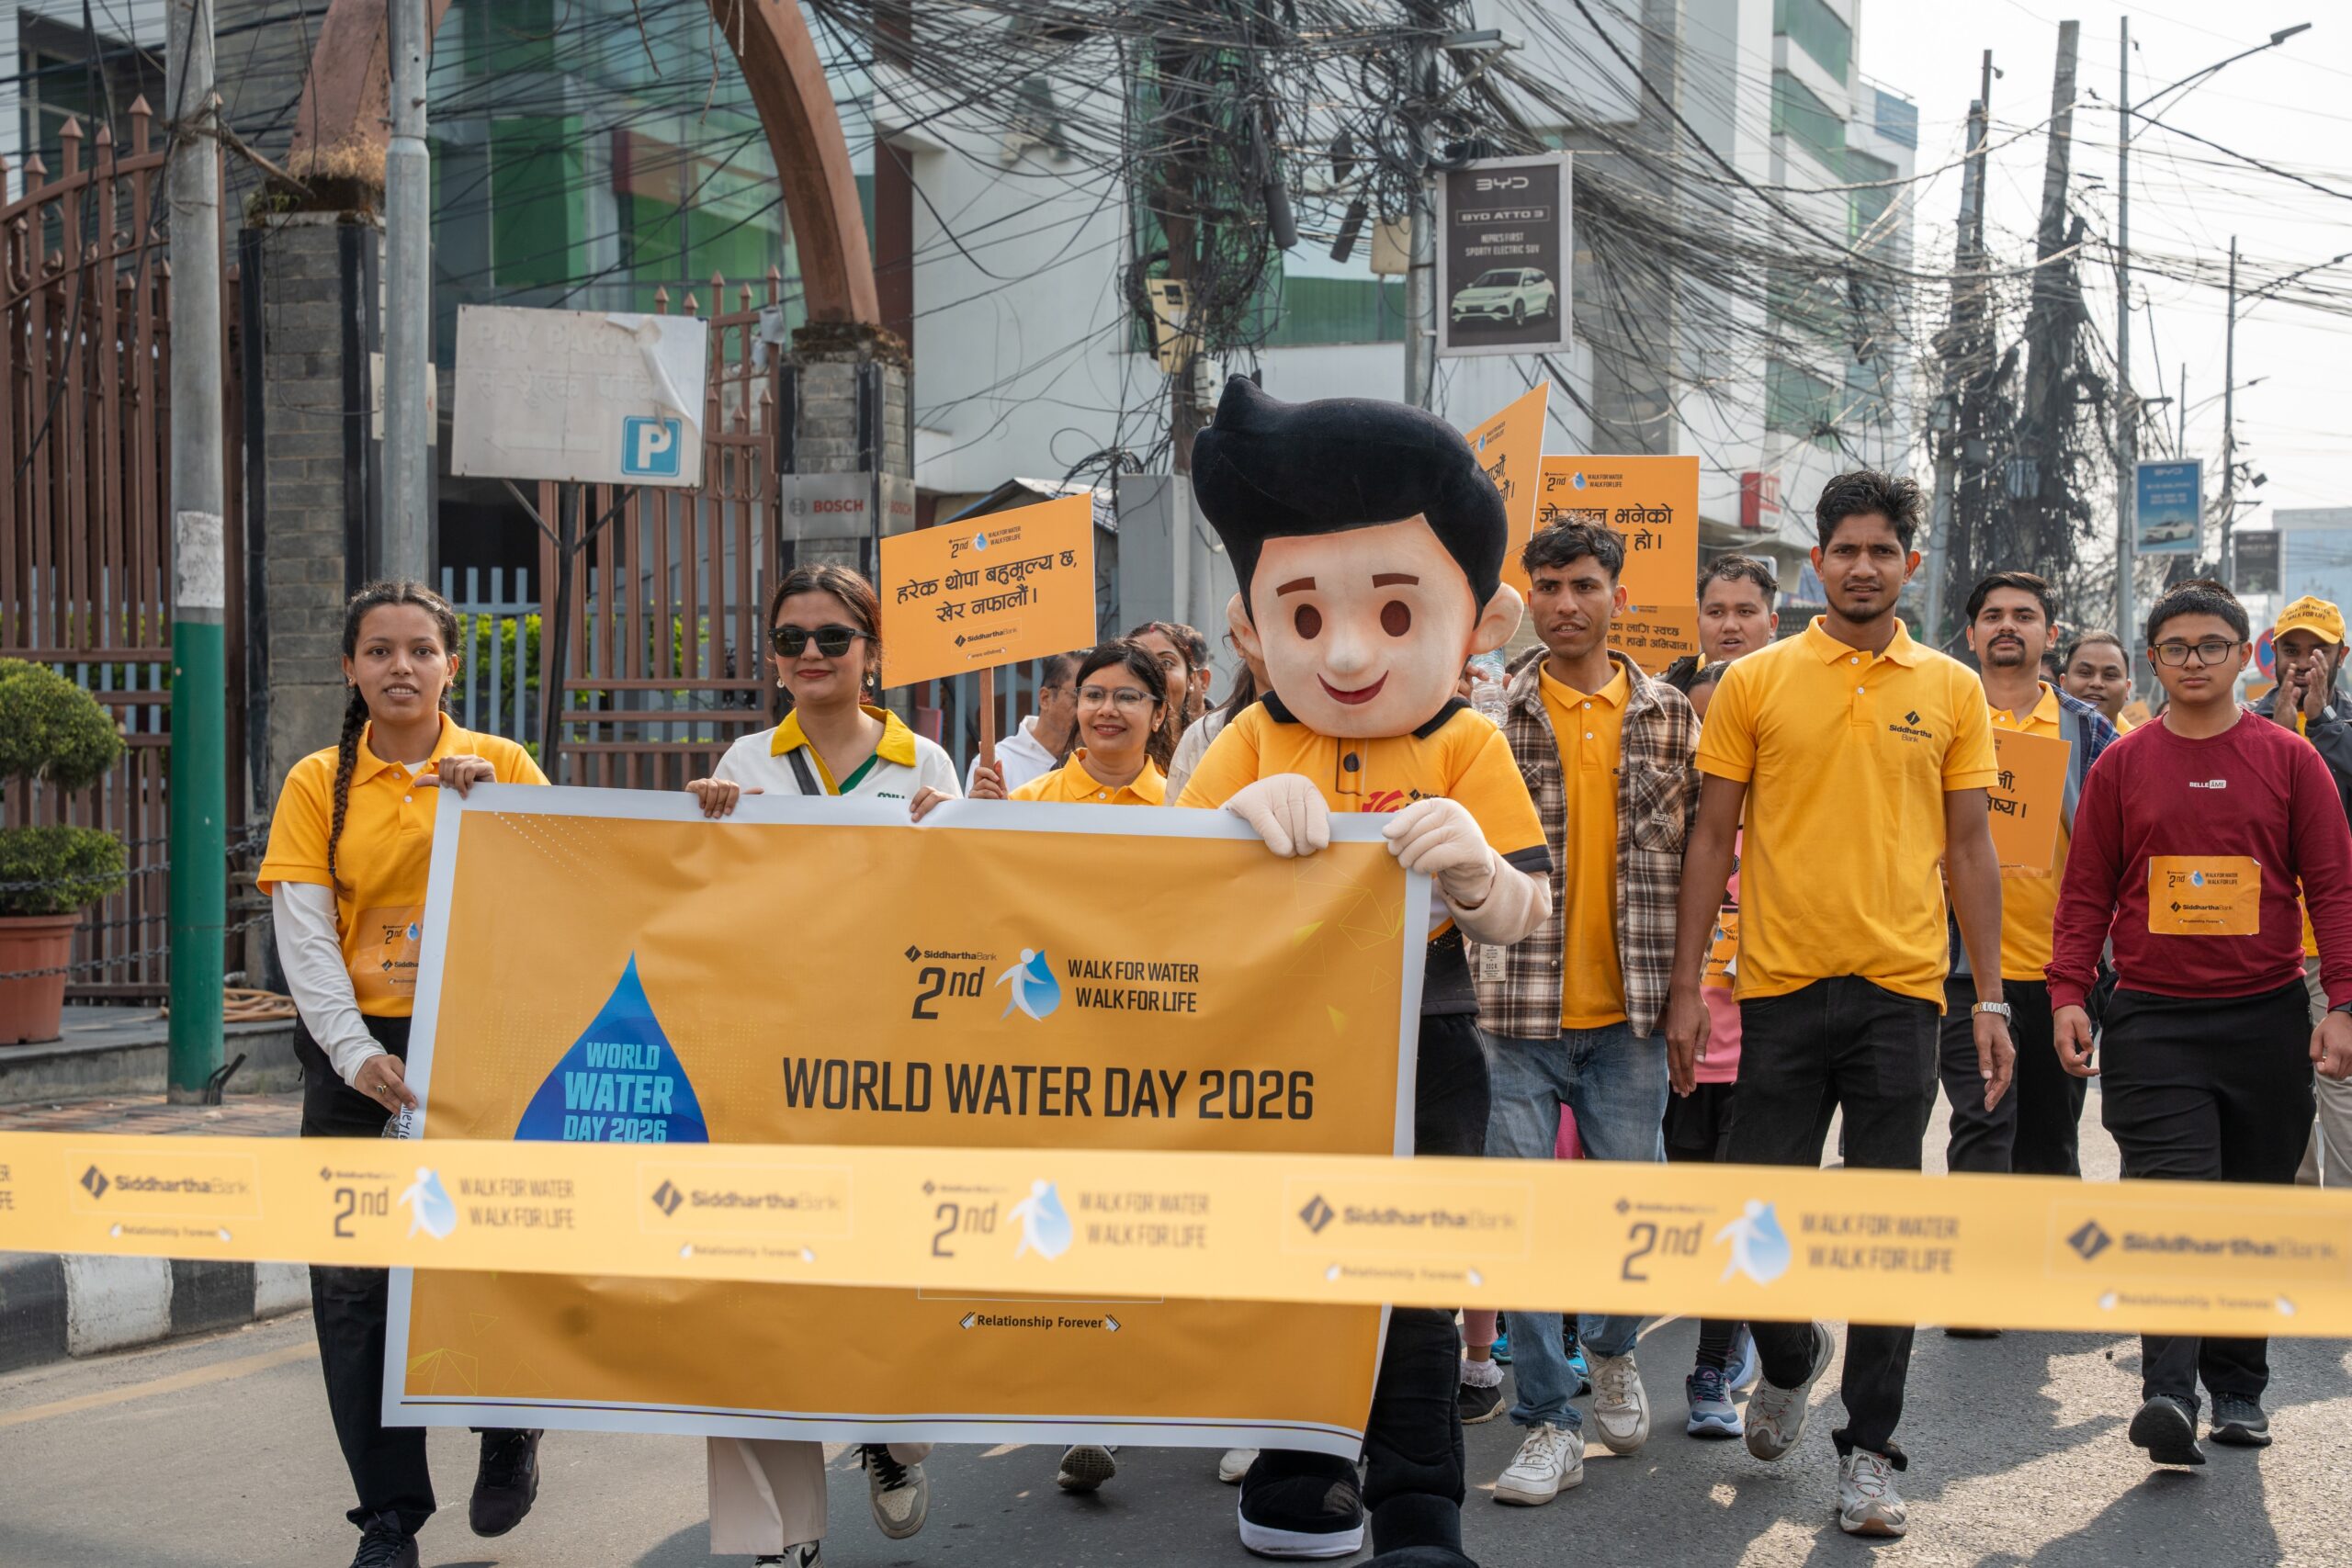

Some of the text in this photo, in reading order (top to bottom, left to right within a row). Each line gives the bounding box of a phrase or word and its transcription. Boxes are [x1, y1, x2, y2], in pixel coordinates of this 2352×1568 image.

[1476, 176, 1529, 191] BYD
[1462, 213, 1490, 221] BYD
[1494, 210, 1531, 220] ATTO
[1493, 245, 1524, 255] ELECTRIC
[638, 423, 672, 468] P
[1547, 478, 1566, 491] 2nd
[813, 500, 864, 513] BOSCH
[1615, 503, 1673, 524] भनेको
[951, 540, 969, 558] 2nd
[1634, 529, 1653, 550] हो
[897, 579, 940, 604] हरेक
[944, 569, 979, 591] थोपा
[985, 554, 1054, 585] बहुमूल्य
[935, 602, 966, 623] खेर
[1626, 623, 1649, 634] लागि
[1650, 638, 1688, 651] अभियान
[1889, 725, 1932, 739] Siddhartha
[1902, 734, 1918, 742] Bank
[2168, 874, 2186, 888] 2nd
[385, 930, 402, 944] 2nd
[923, 950, 998, 961] SiddharthaBank
[1068, 959, 1199, 983] WALK FOR WATER
[911, 966, 985, 1020] 2nd
[1076, 987, 1197, 1012] WALK FOR LIFE
[587, 1043, 661, 1070] WORLD
[565, 1071, 673, 1114] WATER
[783, 1057, 1314, 1121] WORLD WATER DAY 2026
[563, 1115, 667, 1142] DAY 2026
[115, 1175, 250, 1195] SiddharthaBank
[459, 1179, 575, 1198] WALK FOR WATER
[334, 1186, 390, 1237] 2nd
[1079, 1191, 1210, 1215] WALK FOR WATER
[469, 1207, 576, 1229] WALK FOR LIFE
[1800, 1213, 1960, 1240] WALK FOR WATER
[932, 1201, 998, 1257] 2nd
[1087, 1224, 1207, 1248] WALK FOR LIFE
[1621, 1220, 1704, 1282] 2nd
[1807, 1246, 1954, 1273] WALK FOR LIFE
[978, 1315, 1103, 1329] Relationship Forever
